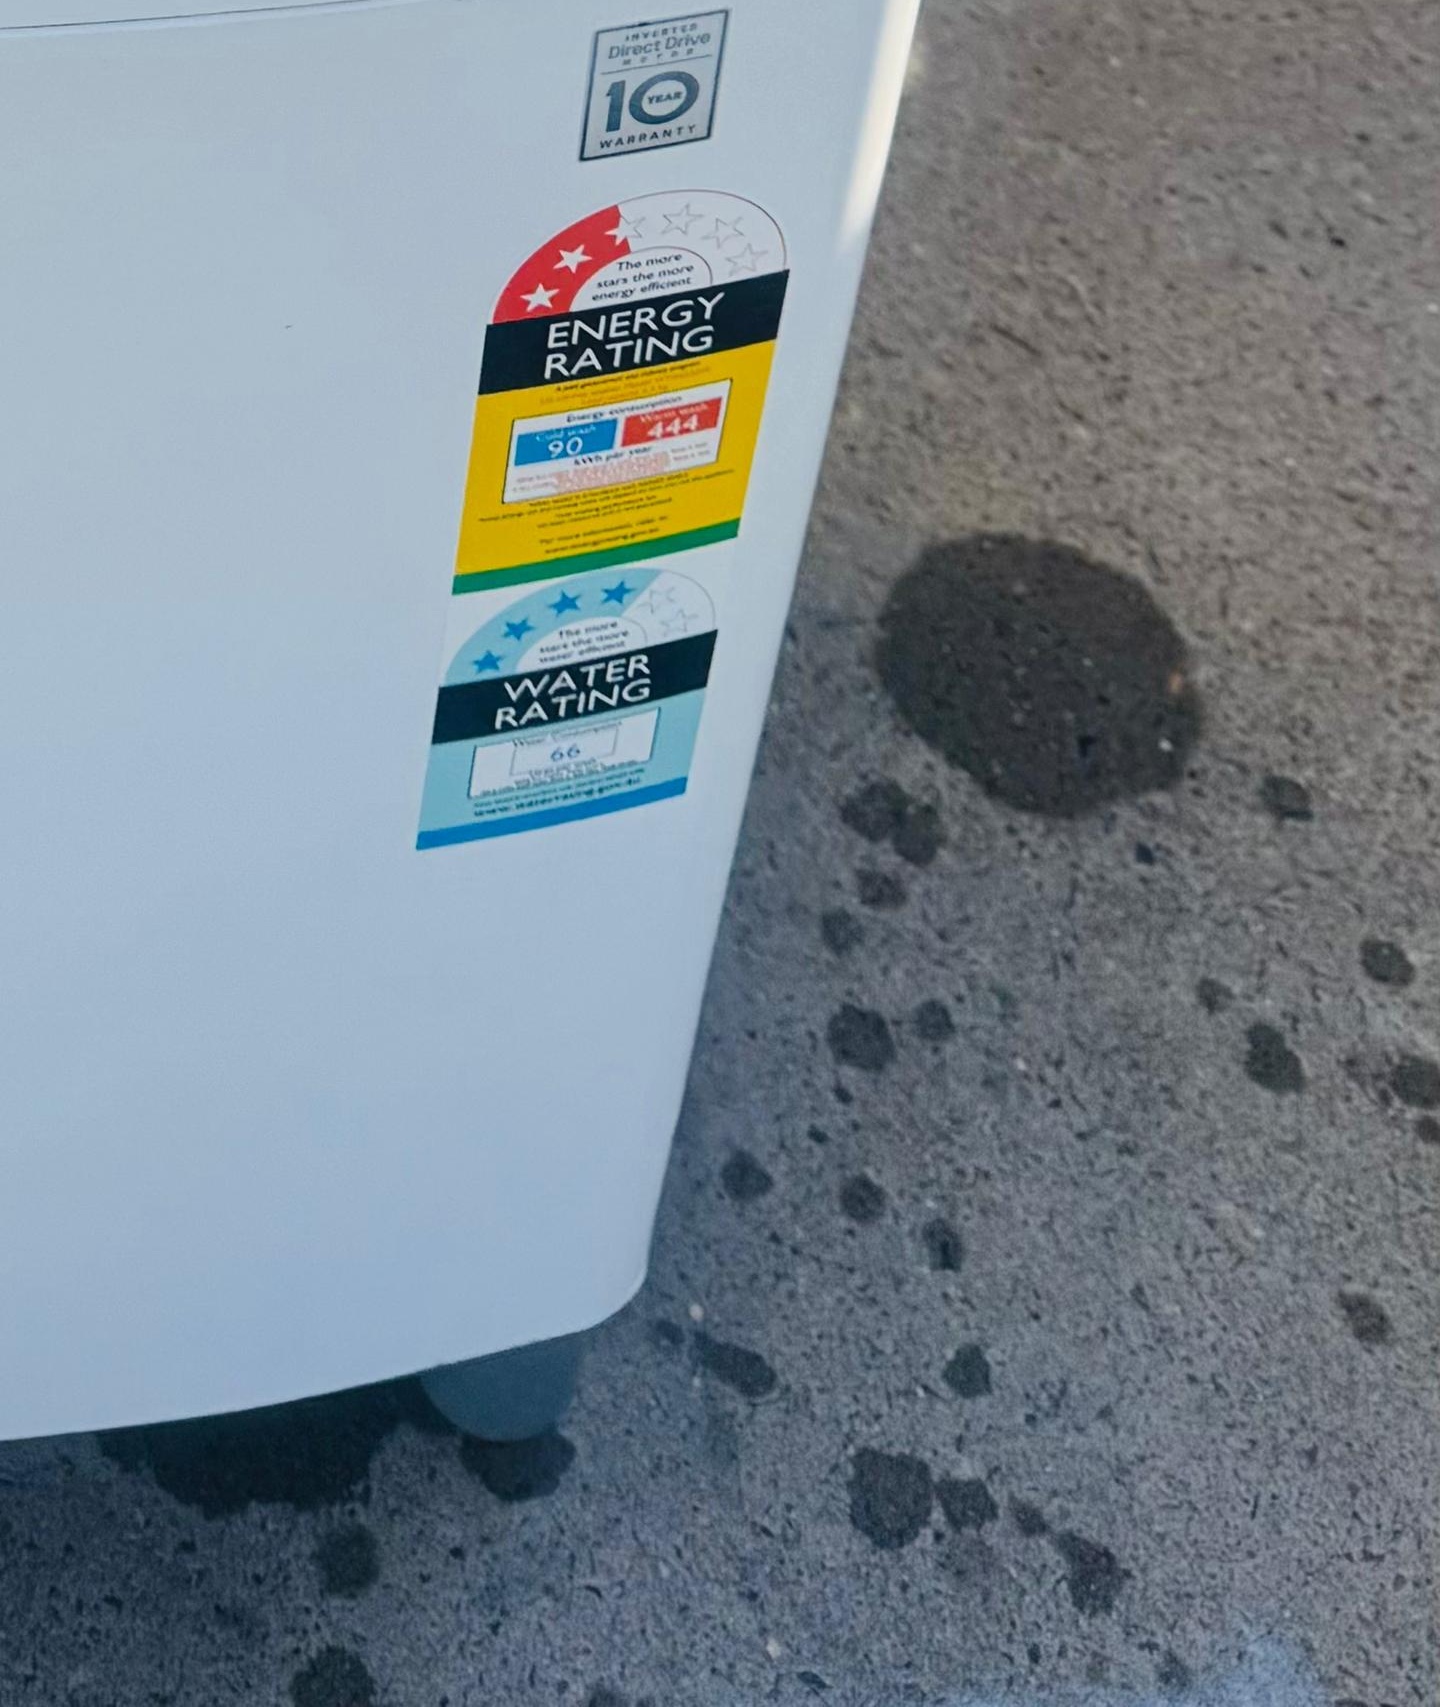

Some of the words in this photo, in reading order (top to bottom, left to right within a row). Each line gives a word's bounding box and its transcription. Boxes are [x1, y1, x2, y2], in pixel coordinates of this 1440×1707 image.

[608, 40, 662, 60] Direct
[664, 32, 712, 51] Drive
[605, 70, 700, 133] 10
[646, 90, 684, 106] YEAR
[599, 123, 697, 150] WARRANTY
[615, 259, 642, 272] The
[645, 252, 683, 267] more
[591, 285, 635, 302] energy
[639, 276, 693, 294] efficient
[596, 275, 629, 289] stars
[632, 267, 654, 284] the
[658, 263, 695, 280] more
[546, 291, 726, 350] ENERGY
[543, 324, 716, 380] RATING
[647, 414, 700, 439] 444
[547, 436, 584, 458] 90
[503, 653, 652, 703] WATER
[494, 678, 651, 731] RATING
